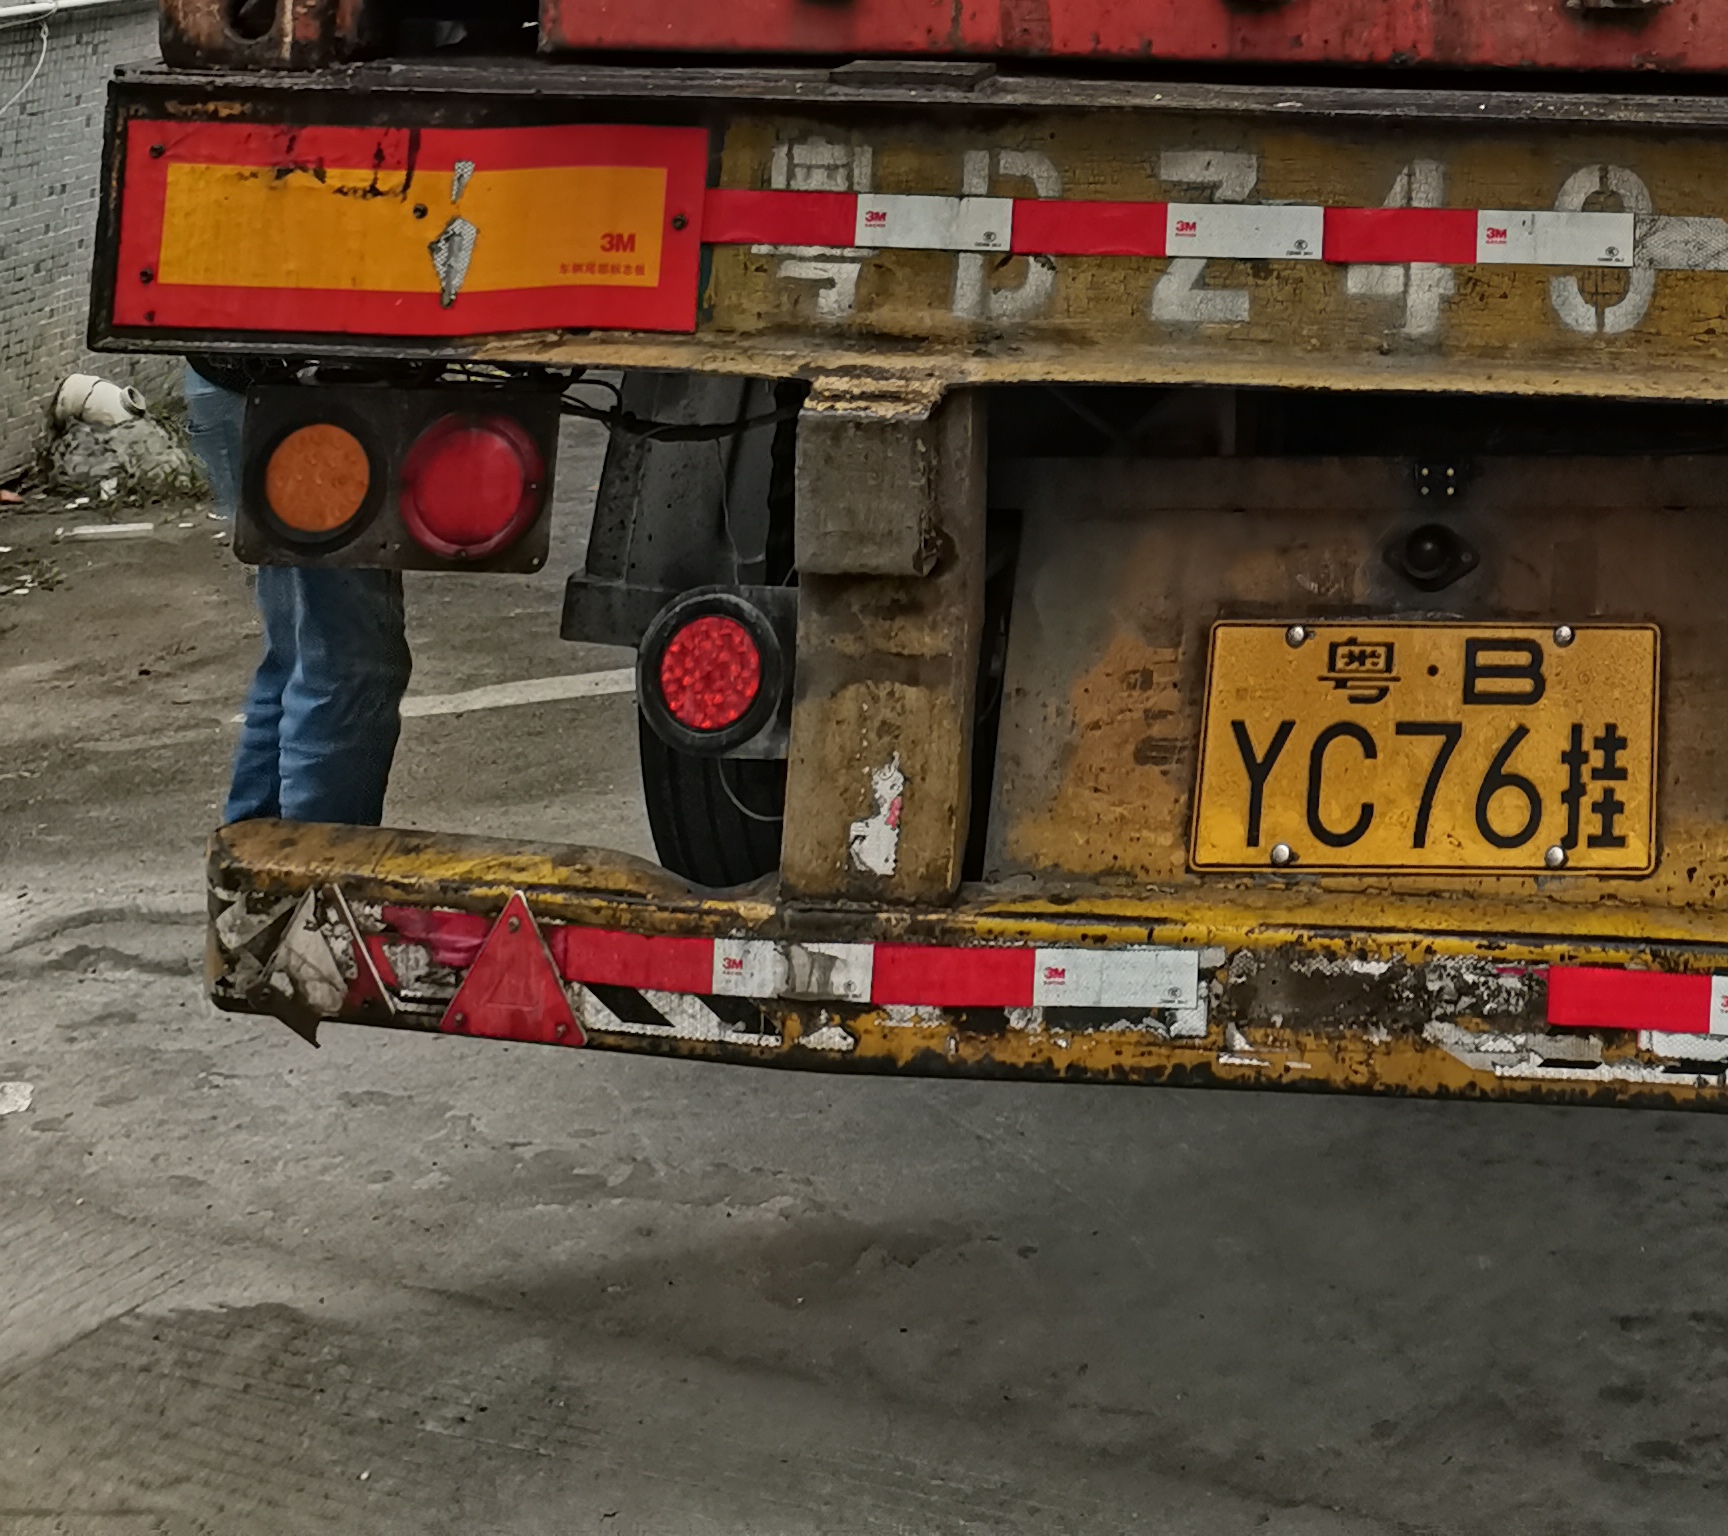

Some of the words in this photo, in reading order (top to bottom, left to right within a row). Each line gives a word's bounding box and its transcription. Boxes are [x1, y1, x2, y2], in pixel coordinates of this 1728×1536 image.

[865, 210, 887, 222] 3M
[1175, 220, 1197, 232] 3M
[1486, 227, 1507, 239] 3M
[600, 232, 636, 253] 3M
[1231, 719, 1628, 849] YC76挂
[722, 957, 743, 970] 3M
[1044, 966, 1066, 980] 3M
